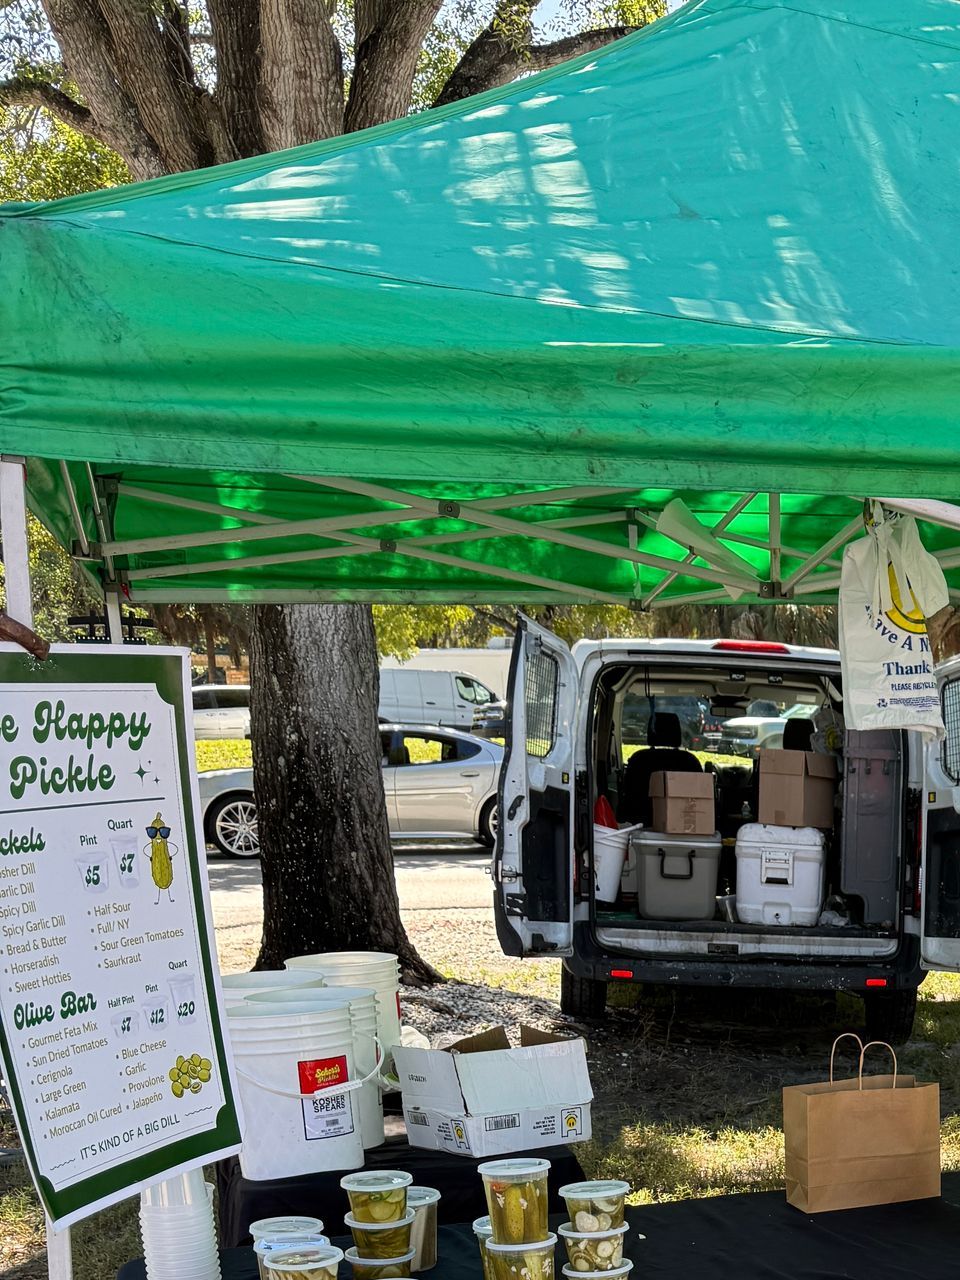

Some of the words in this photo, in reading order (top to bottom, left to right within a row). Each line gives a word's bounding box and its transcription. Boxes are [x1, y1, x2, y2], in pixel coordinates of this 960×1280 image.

[901, 635, 913, 651] A
[883, 660, 932, 676] Thank
[891, 683, 912, 691] PLEASE
[0, 714, 19, 743] e
[33, 700, 151, 750] Happy
[10, 754, 116, 799] Pickle
[107, 819, 133, 831] Quart
[0, 827, 46, 856] ckels
[80, 835, 98, 846] Pint
[21, 862, 36, 875] Dill
[120, 853, 135, 874] $7
[85, 865, 100, 887] $5
[0, 885, 19, 898] arlic
[20, 882, 35, 895] Dill
[22, 900, 37, 914] Dill
[94, 903, 111, 916] Half
[113, 902, 131, 914] Sour
[2, 924, 24, 938] Spicy
[26, 918, 50, 932] Garlic
[51, 915, 66, 928] Dill
[117, 918, 130, 931] NY
[6, 941, 31, 956] Bread
[33, 939, 39, 950] &
[41, 935, 67, 949] Butter
[100, 940, 119, 952] Sour
[120, 935, 145, 947] Green
[145, 928, 185, 943] Tomatoes
[10, 954, 60, 974] Horseradish
[104, 952, 142, 969] Saurkraut
[168, 959, 188, 970] Quart
[15, 978, 40, 993] Sweet
[41, 971, 72, 986] Hotties
[145, 984, 159, 994] Pint
[14, 1001, 55, 1031] Olive
[60, 991, 97, 1020] Bar
[107, 997, 121, 1009] Half
[122, 995, 135, 1006] Pint
[177, 1000, 195, 1019] $20
[121, 1017, 132, 1034] $7
[150, 1008, 165, 1025] $12
[28, 1031, 62, 1049] Gourmet
[64, 1027, 81, 1040] Feta
[82, 1021, 98, 1034] Mix
[32, 1055, 47, 1067] Sun
[48, 1046, 70, 1062] Dried
[70, 1037, 108, 1056] Tomatoes
[121, 1047, 139, 1060] Blue
[140, 1039, 167, 1054] Cheese
[37, 1066, 73, 1085] Cerignola
[125, 1062, 147, 1076] Garlic
[41, 1088, 62, 1103] Large
[63, 1081, 87, 1095] Green
[128, 1074, 165, 1093] Provolone
[132, 1091, 163, 1110] Jalapeño
[312, 1094, 346, 1107] KOSHER
[313, 1101, 346, 1113] SPEARS
[45, 1101, 80, 1121] Kalamata
[50, 1117, 86, 1139] Moroccan
[87, 1111, 98, 1125] Oil
[100, 1103, 123, 1119] Cured
[80, 1144, 97, 1160] IT'S
[98, 1135, 121, 1152] KIND
[122, 1129, 135, 1143] OF
[137, 1127, 144, 1139] A
[145, 1120, 160, 1135] BIG
[161, 1113, 181, 1129] DILL
